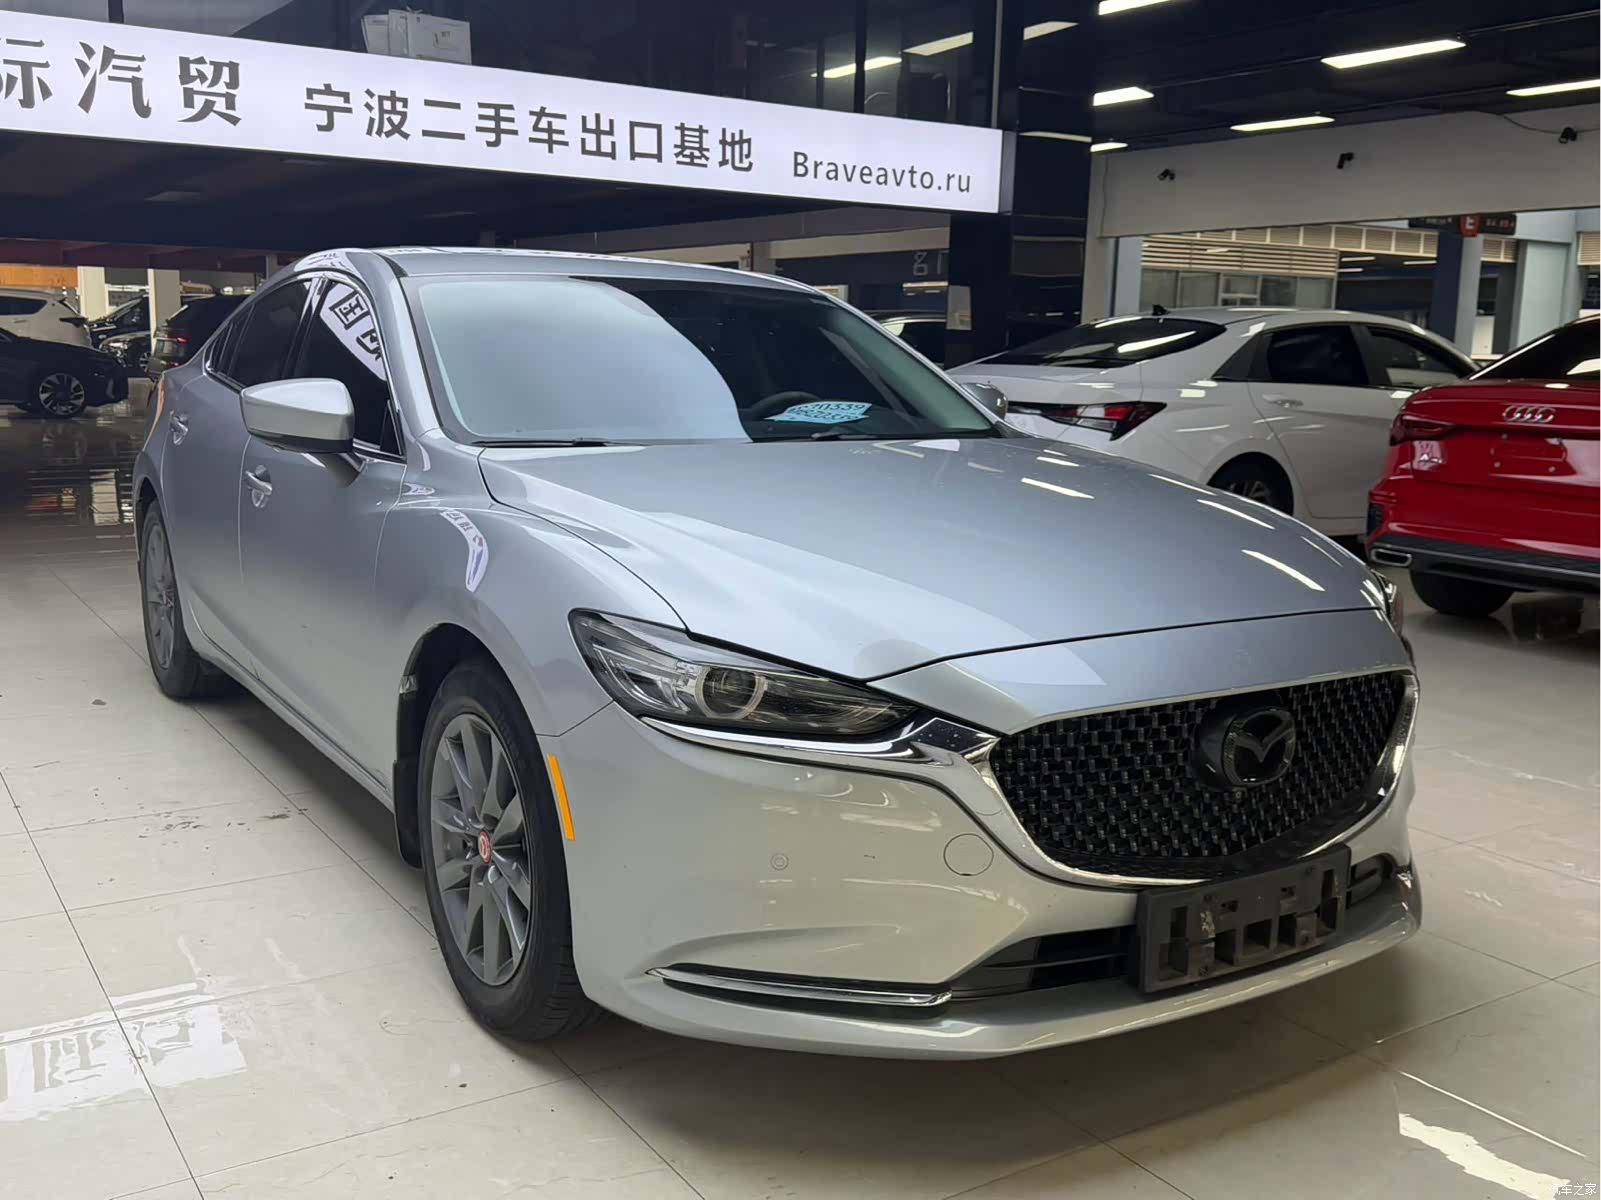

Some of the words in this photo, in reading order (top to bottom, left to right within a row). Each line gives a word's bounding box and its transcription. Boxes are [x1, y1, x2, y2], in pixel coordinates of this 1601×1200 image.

[304, 83, 754, 172] 宁波二手车出口基地
[793, 151, 971, 193] Braveavto.ru
